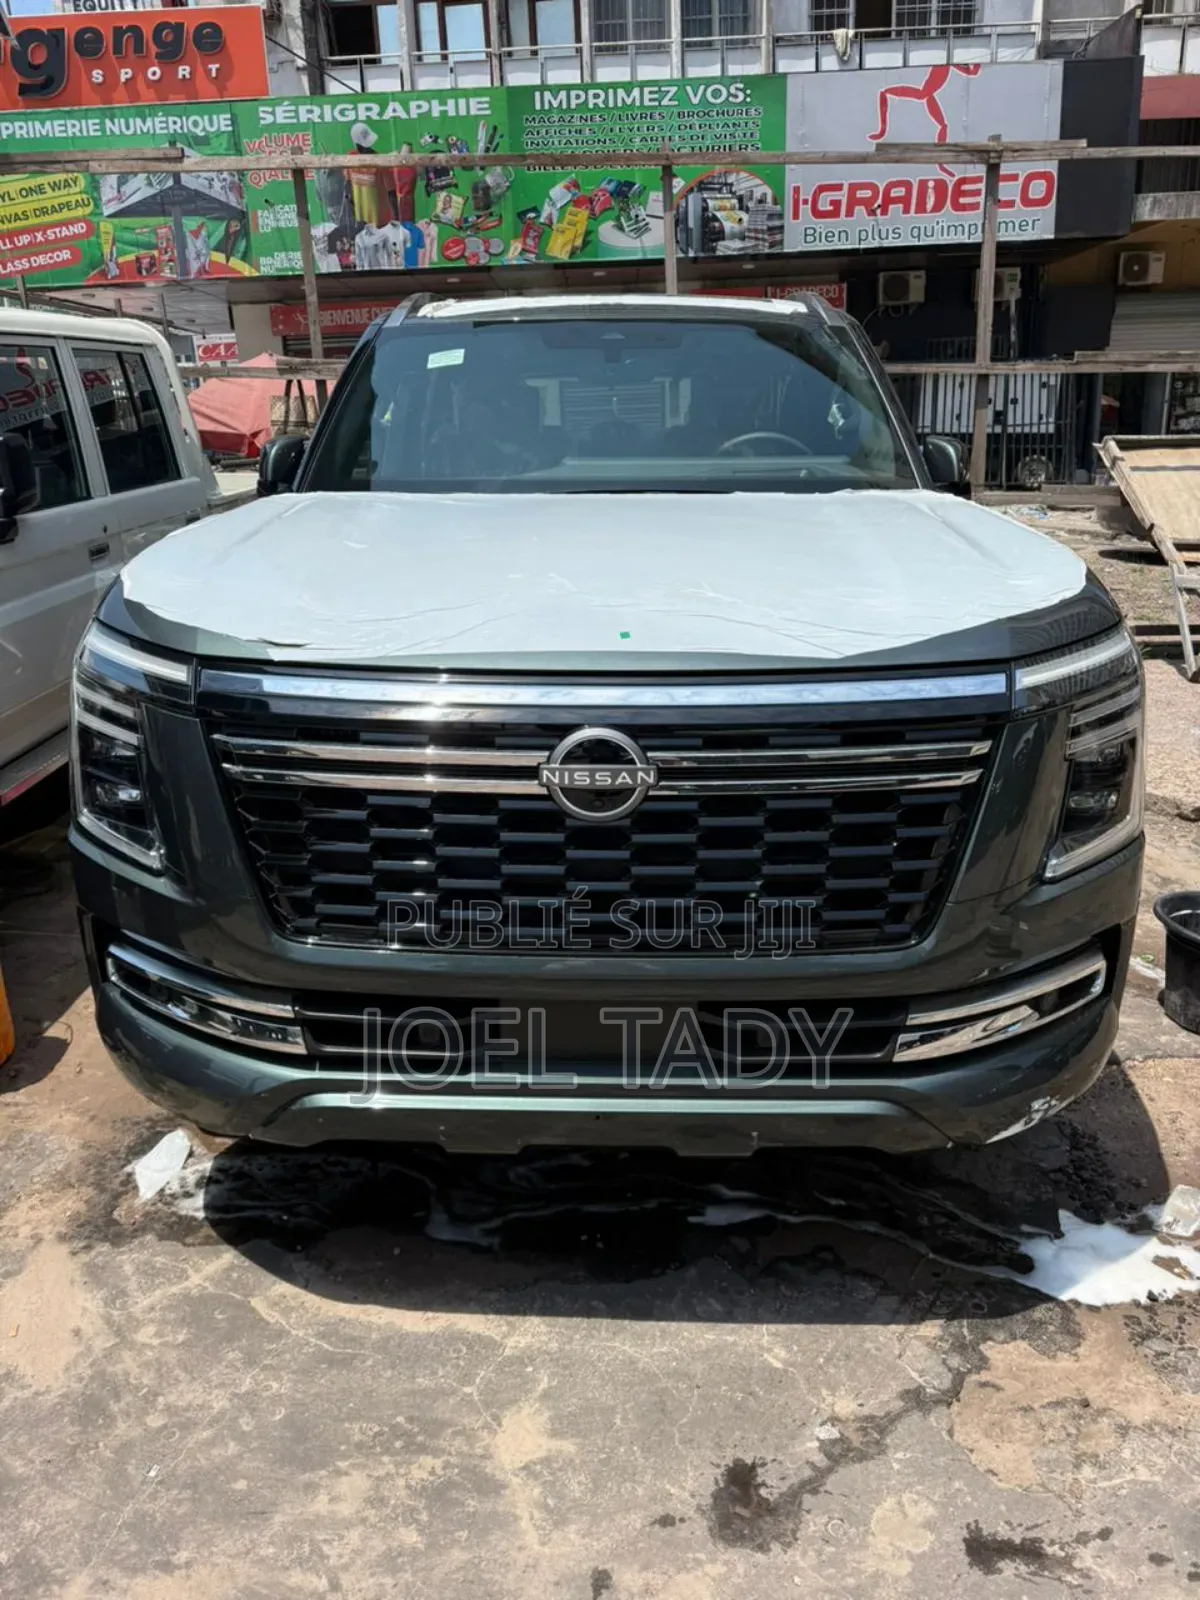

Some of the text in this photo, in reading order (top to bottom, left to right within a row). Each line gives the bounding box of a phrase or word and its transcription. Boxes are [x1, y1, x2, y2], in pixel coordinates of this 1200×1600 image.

[0, 20, 223, 97] genge
[91, 63, 220, 83] SPORT
[534, 83, 751, 111] IMPRIMEZ VOS:
[258, 97, 492, 125] SÉRIGRAPHIE
[524, 113, 607, 125] MAGAZINES
[618, 112, 665, 122] LIVRES
[677, 108, 762, 120] BROCHURES
[0, 113, 234, 139] PRIMERIE NUMÉRIQUE
[525, 128, 597, 137] AFFICHES
[609, 125, 665, 134] FLYERS
[525, 138, 616, 148] INVITATIONS
[629, 134, 686, 144] CARTES
[713, 131, 759, 141] VISITE
[18, 183, 48, 199] ONE
[47, 176, 79, 193] WAY
[33, 196, 91, 218] DRAPEAU
[14, 234, 31, 246] UP
[35, 222, 87, 243] X-STAND
[803, 218, 1041, 246] Bien plus qu'impmer
[30, 249, 72, 267] DECOR
[543, 770, 655, 785] NISSAN
